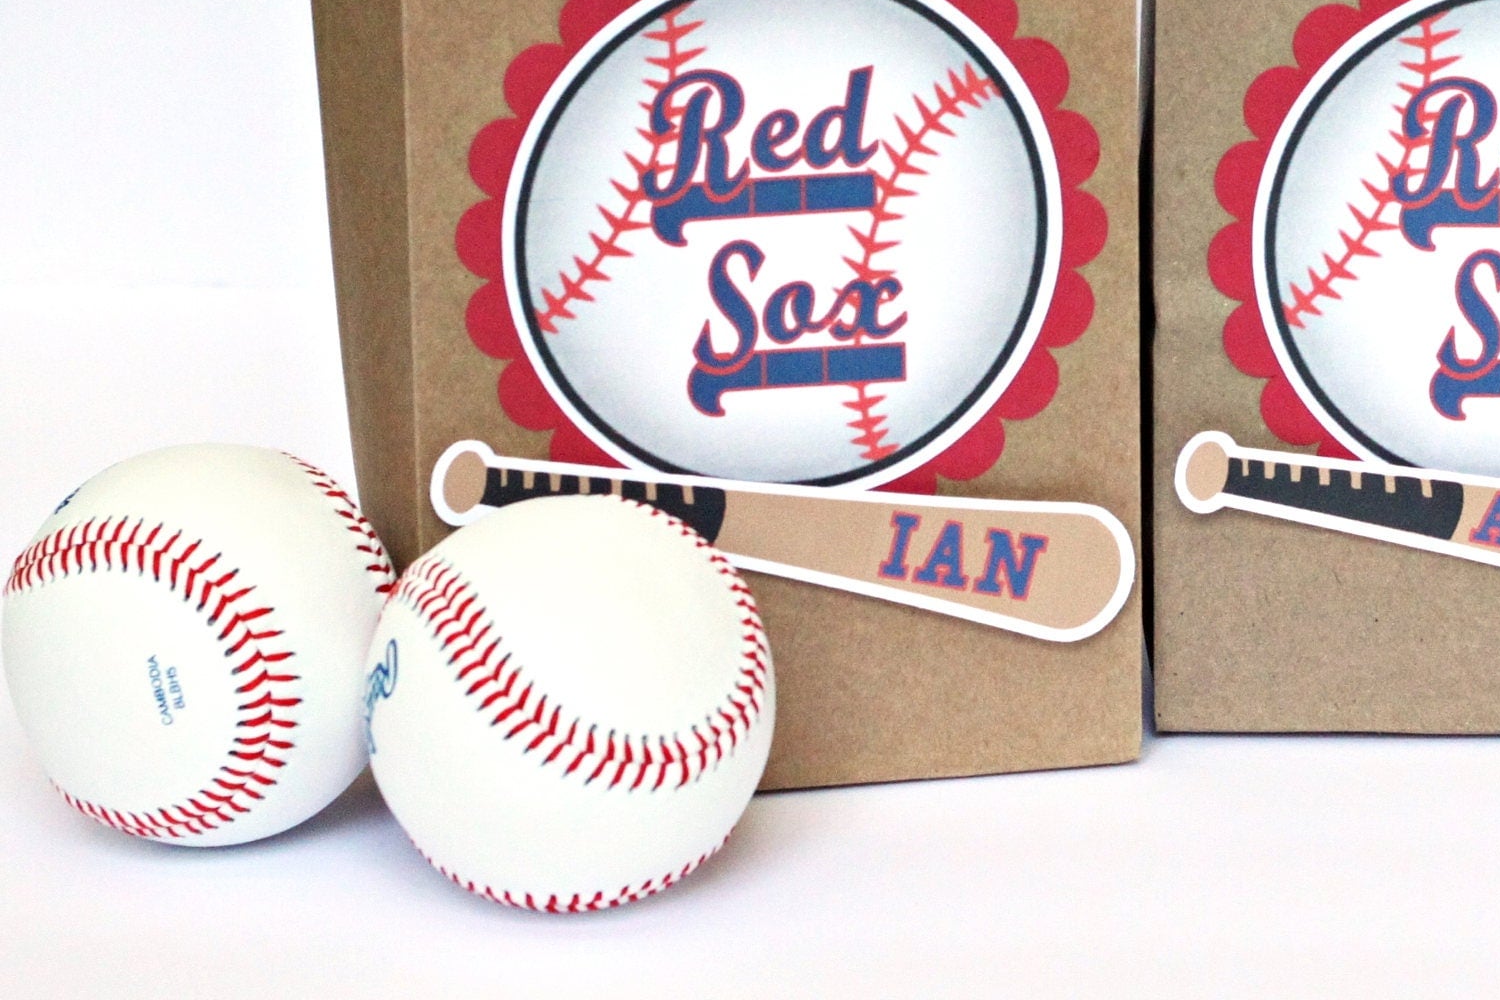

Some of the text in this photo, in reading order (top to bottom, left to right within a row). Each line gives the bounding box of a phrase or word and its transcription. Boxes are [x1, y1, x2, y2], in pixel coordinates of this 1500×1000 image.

[640, 65, 880, 205] Red
[692, 239, 908, 376] Sox
[877, 511, 1049, 600] IAN
[147, 654, 174, 726] CAMBODIA
